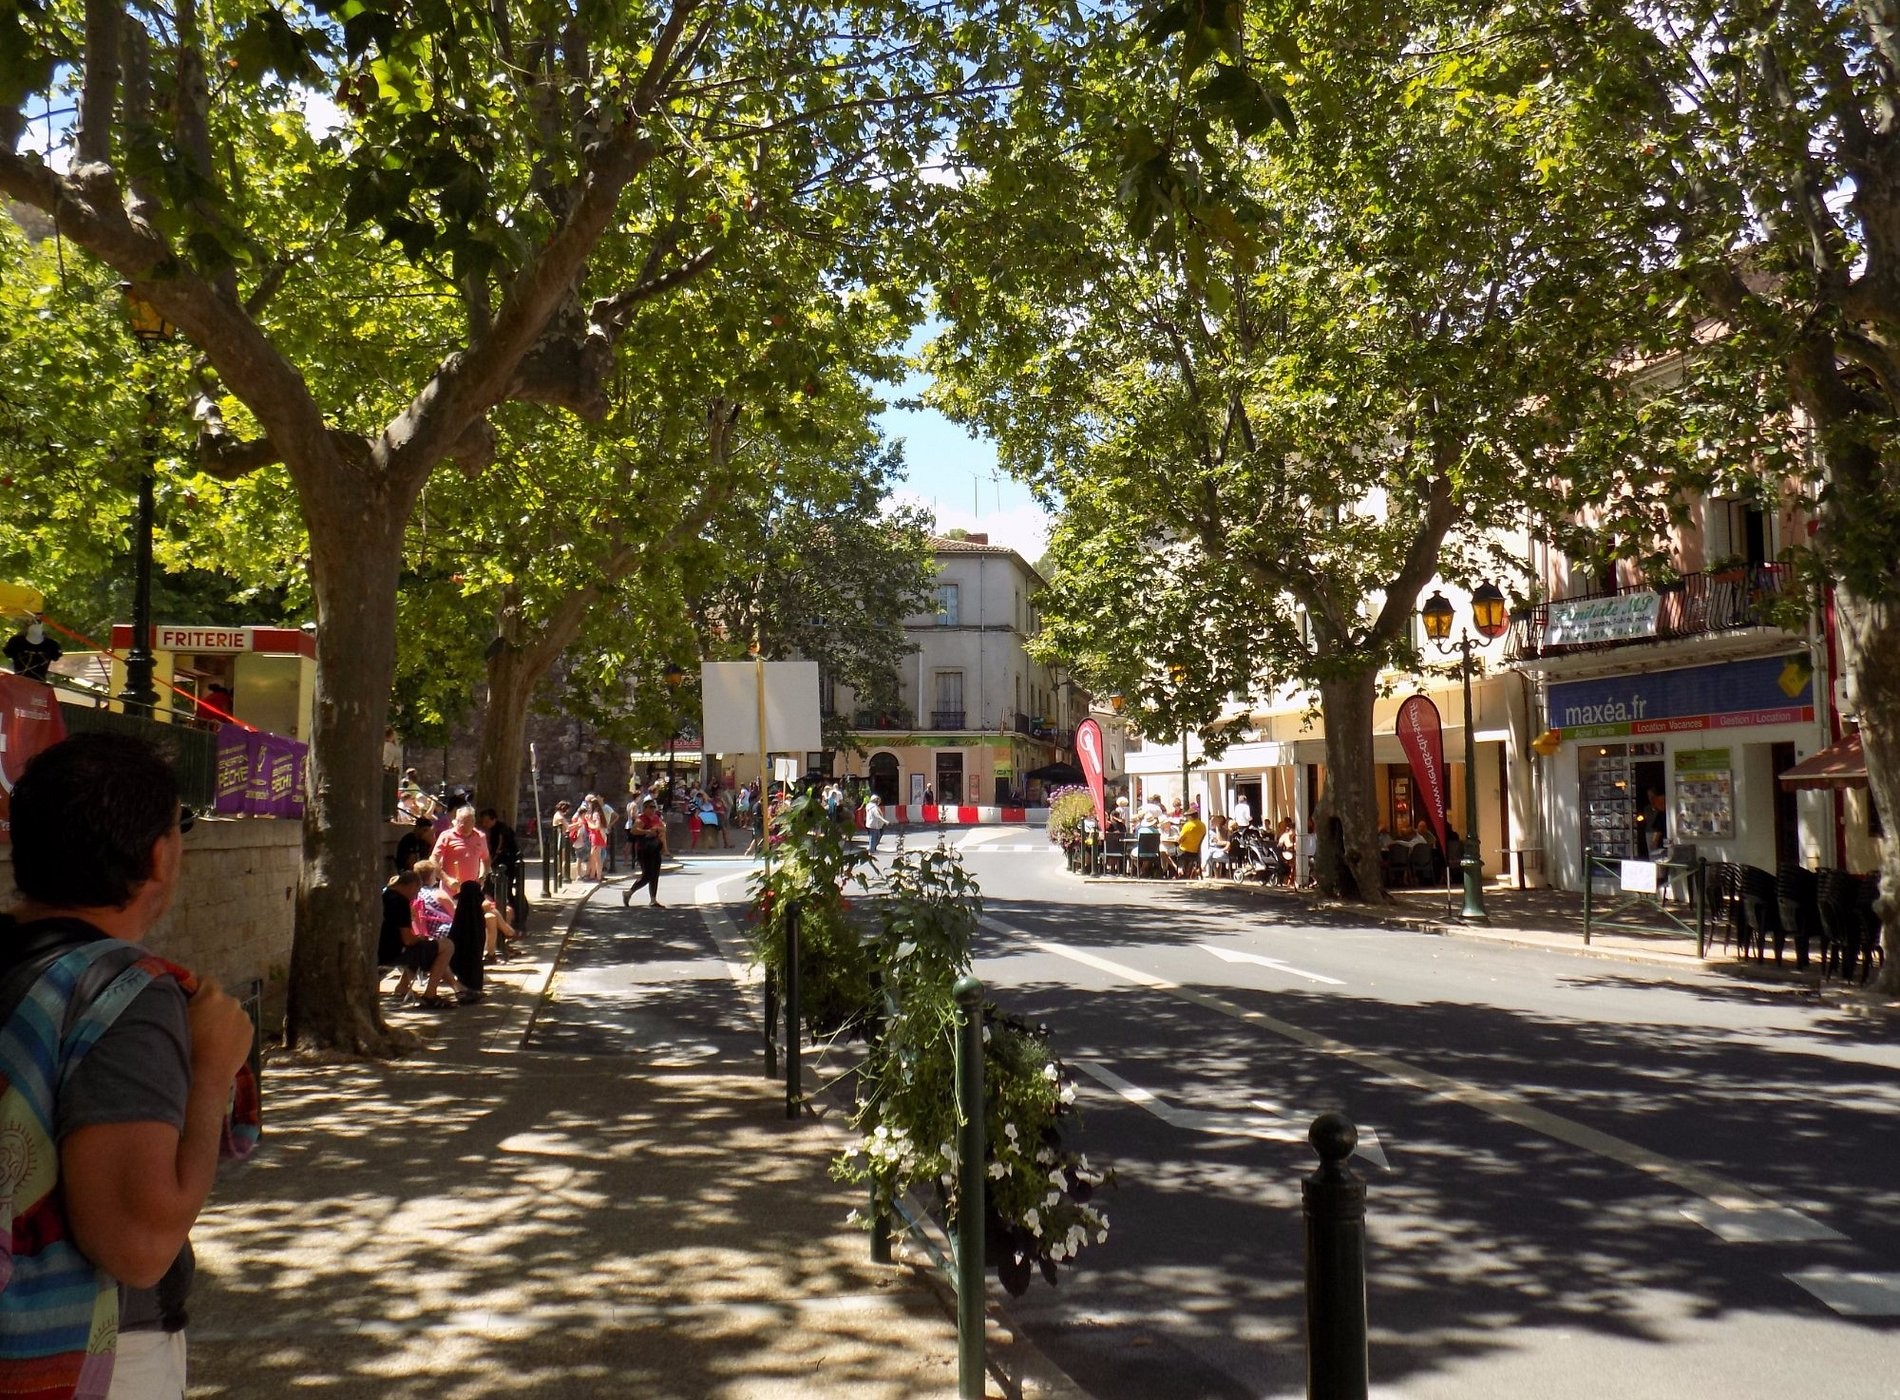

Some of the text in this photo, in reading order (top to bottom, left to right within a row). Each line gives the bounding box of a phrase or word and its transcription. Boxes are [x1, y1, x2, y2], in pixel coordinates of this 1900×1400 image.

[163, 631, 244, 648] FRITERIE
[1566, 695, 1647, 725] maxéa.fr
[1637, 718, 1703, 733] Location Vacances
[1719, 714, 1750, 726] Gestion
[1756, 711, 1791, 723] Location
